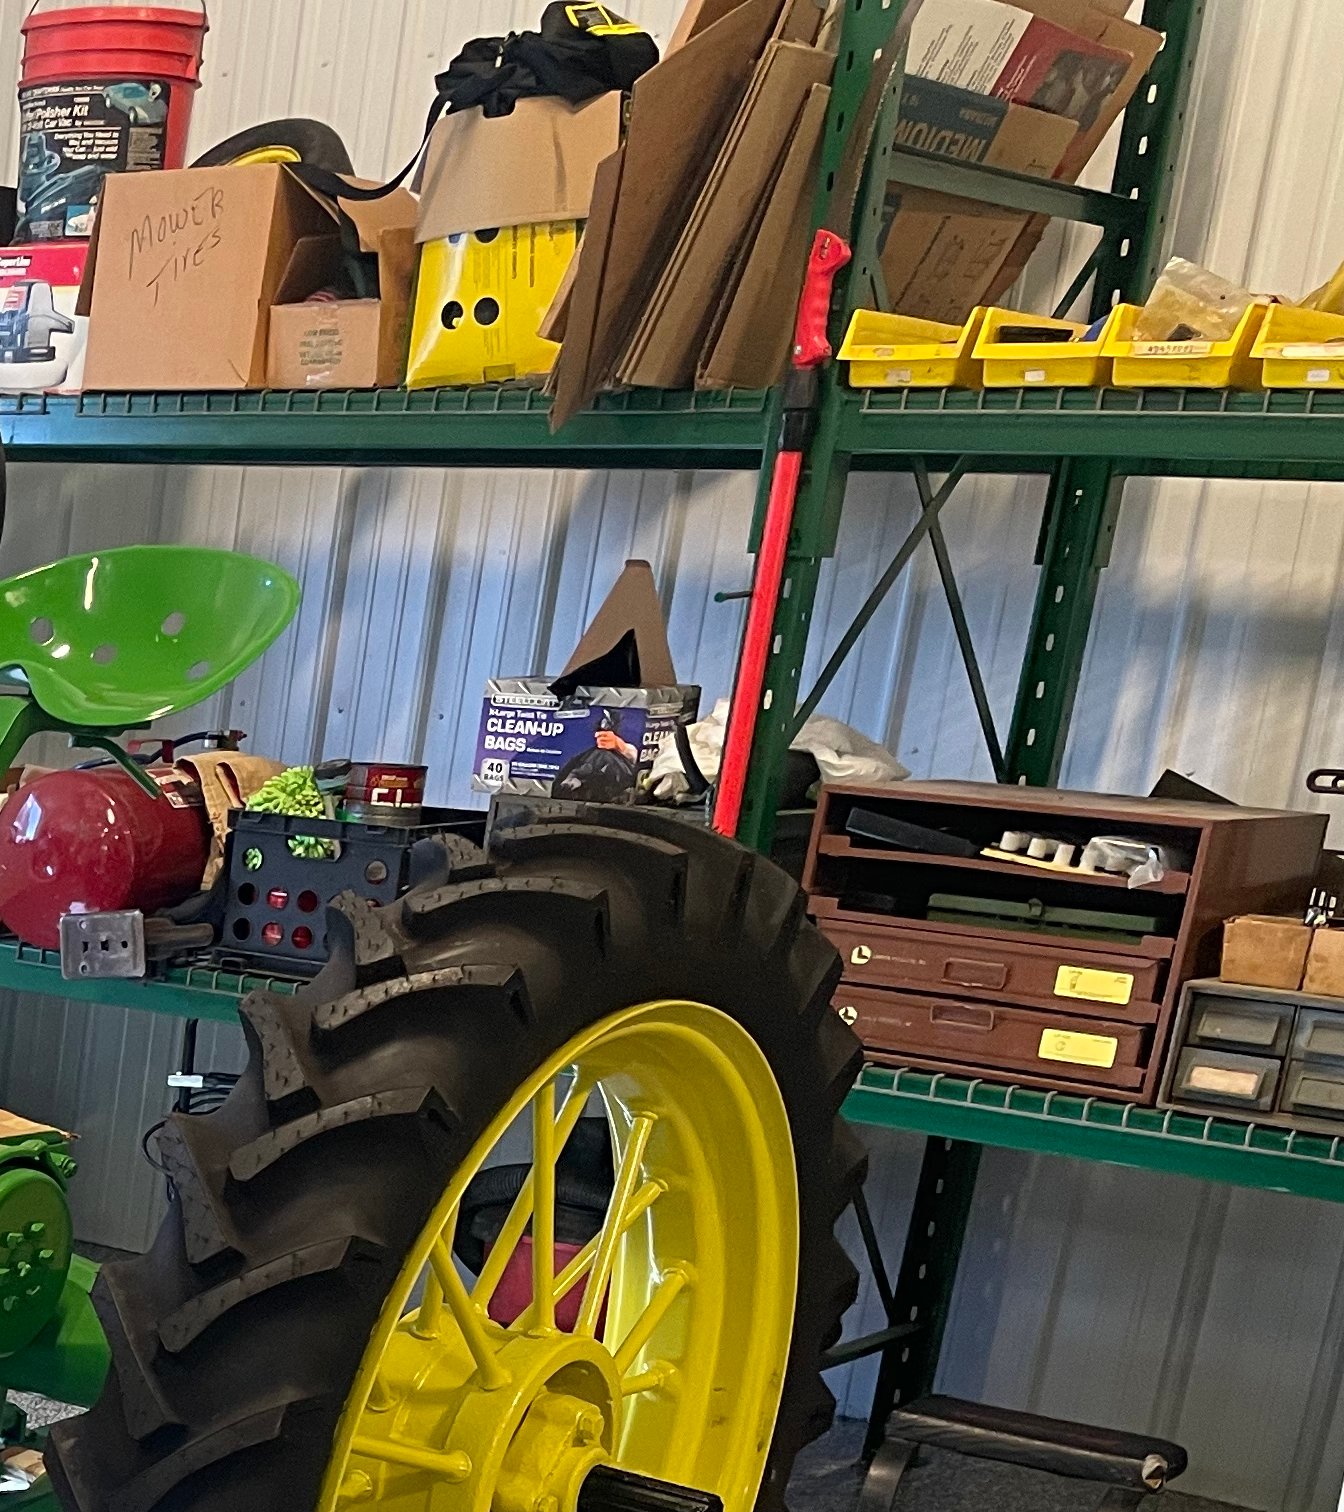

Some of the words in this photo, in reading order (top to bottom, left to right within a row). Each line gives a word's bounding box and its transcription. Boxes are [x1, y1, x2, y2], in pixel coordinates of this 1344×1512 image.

[128, 186, 224, 280] MOWER
[487, 717, 564, 737] CLEAN-UP
[484, 735, 526, 752] BAGS
[487, 763, 503, 773] 40
[483, 773, 504, 782] BAGS
